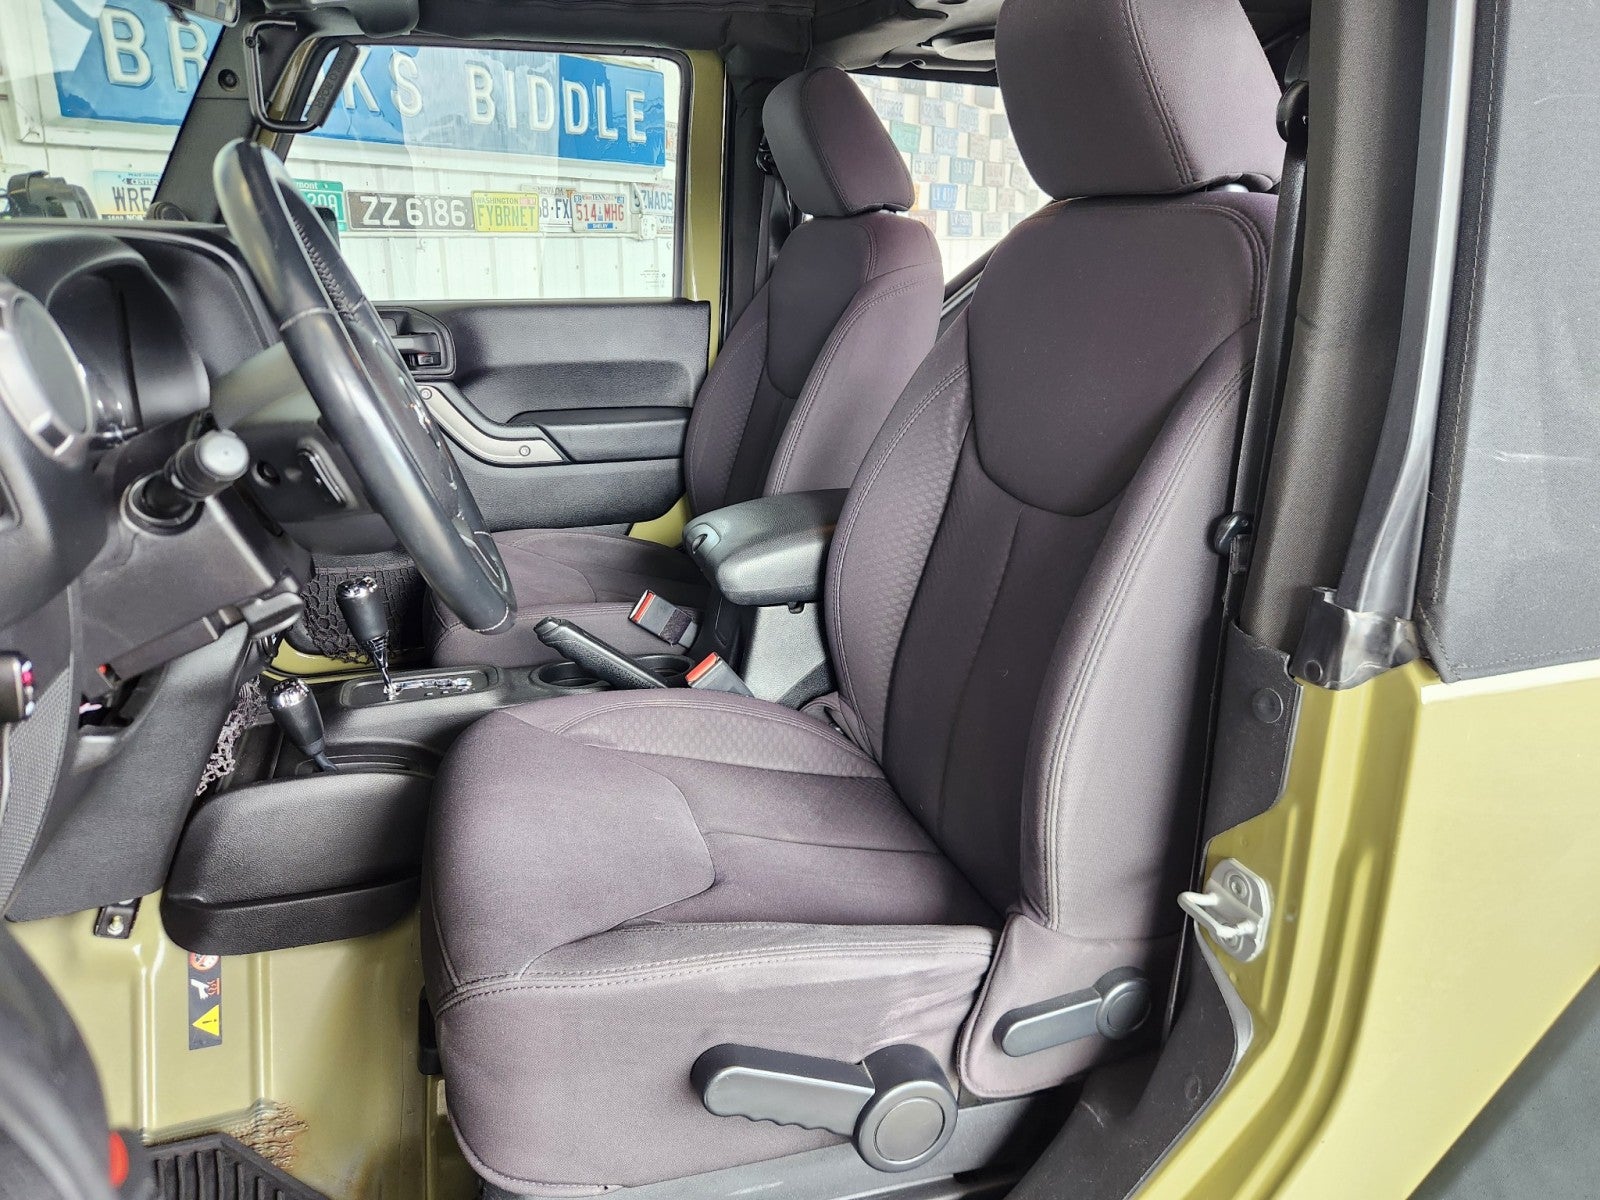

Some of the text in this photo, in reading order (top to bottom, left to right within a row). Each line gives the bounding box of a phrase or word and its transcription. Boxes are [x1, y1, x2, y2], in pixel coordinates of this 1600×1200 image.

[464, 62, 648, 143] BIDDLE
[296, 181, 318, 190] mont
[360, 195, 467, 227] ZZ 6186
[475, 196, 519, 205] WASHINGTON
[477, 204, 536, 227] FYBRNET
[576, 203, 624, 222] 514 MHG
